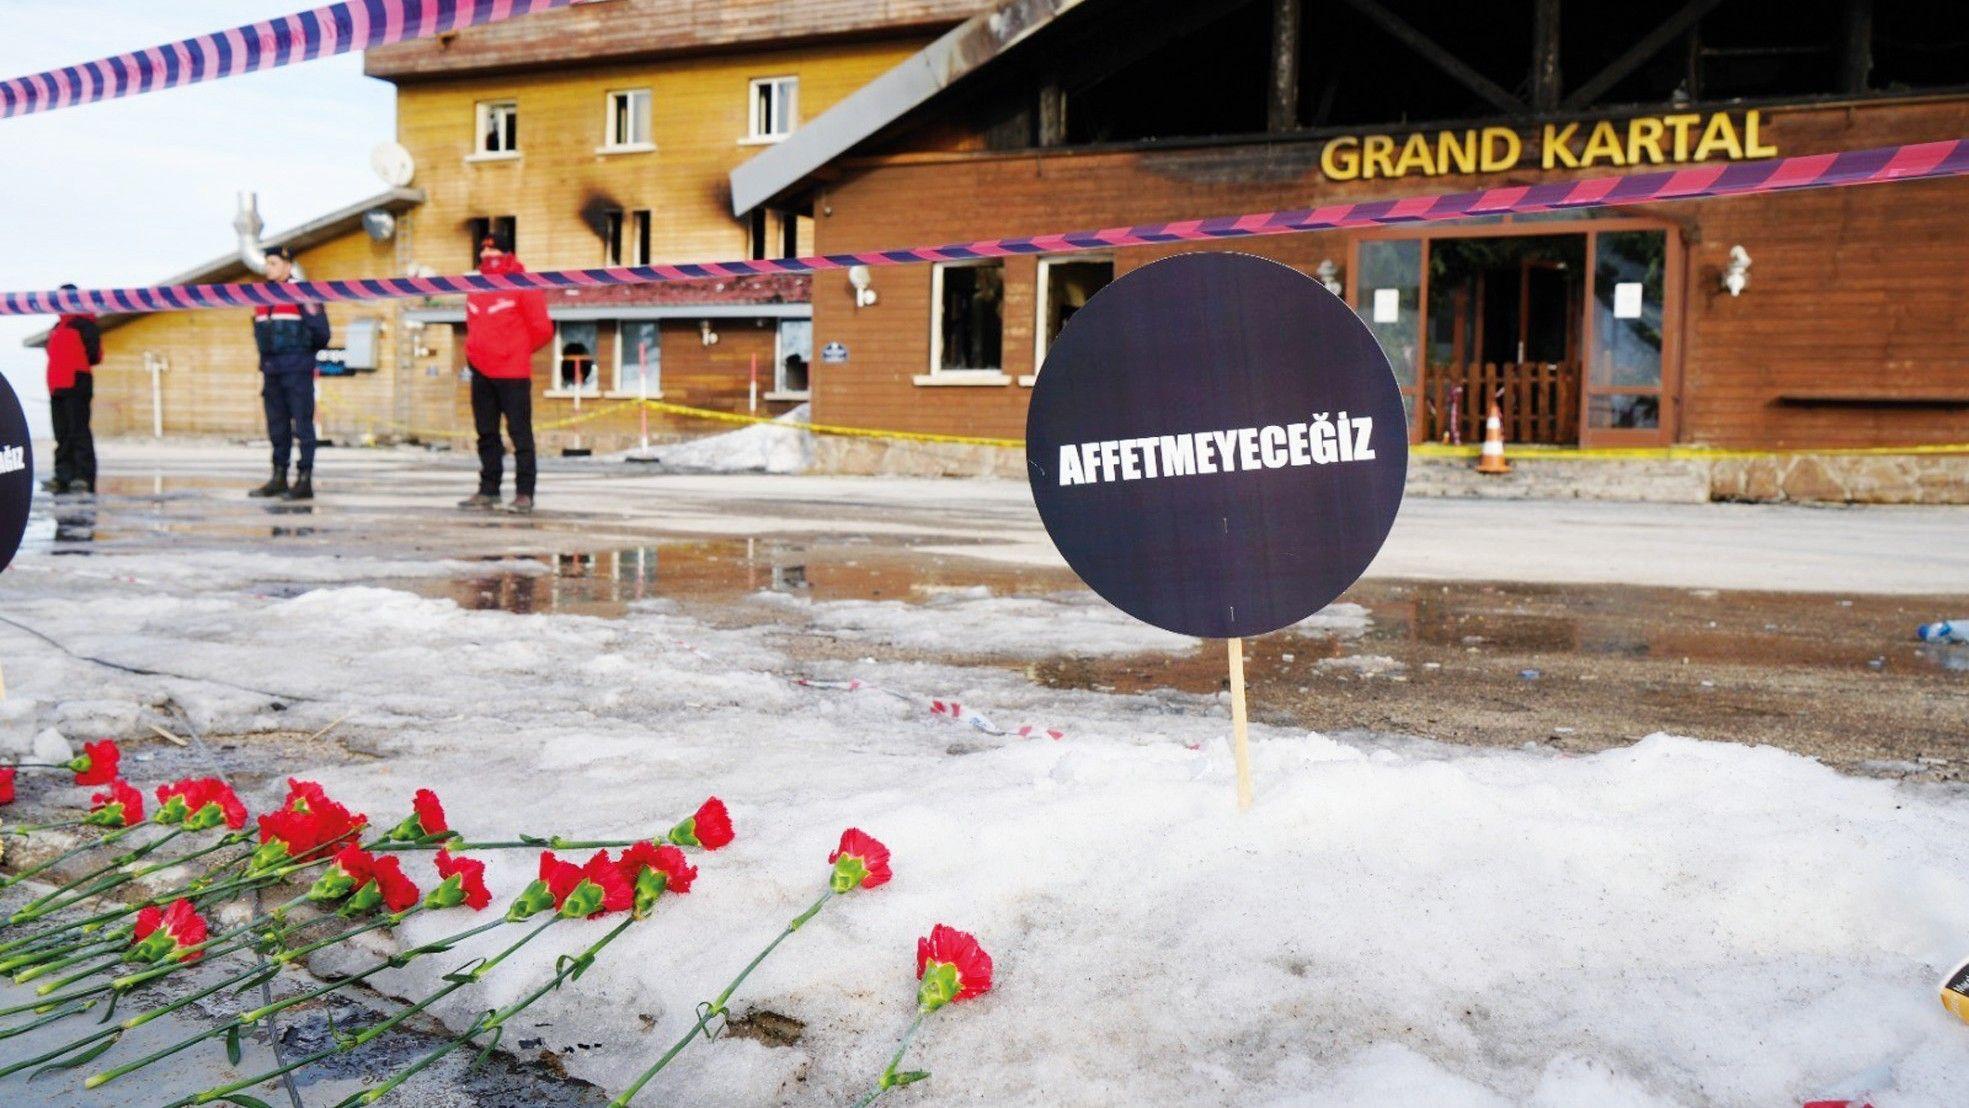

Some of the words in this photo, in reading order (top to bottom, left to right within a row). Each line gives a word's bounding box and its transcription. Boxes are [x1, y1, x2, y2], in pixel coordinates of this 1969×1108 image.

[1320, 126, 1522, 181] GRAND
[1541, 109, 1778, 169] KARTAL
[1058, 411, 1376, 486] AFFETMEYECEĞİZ
